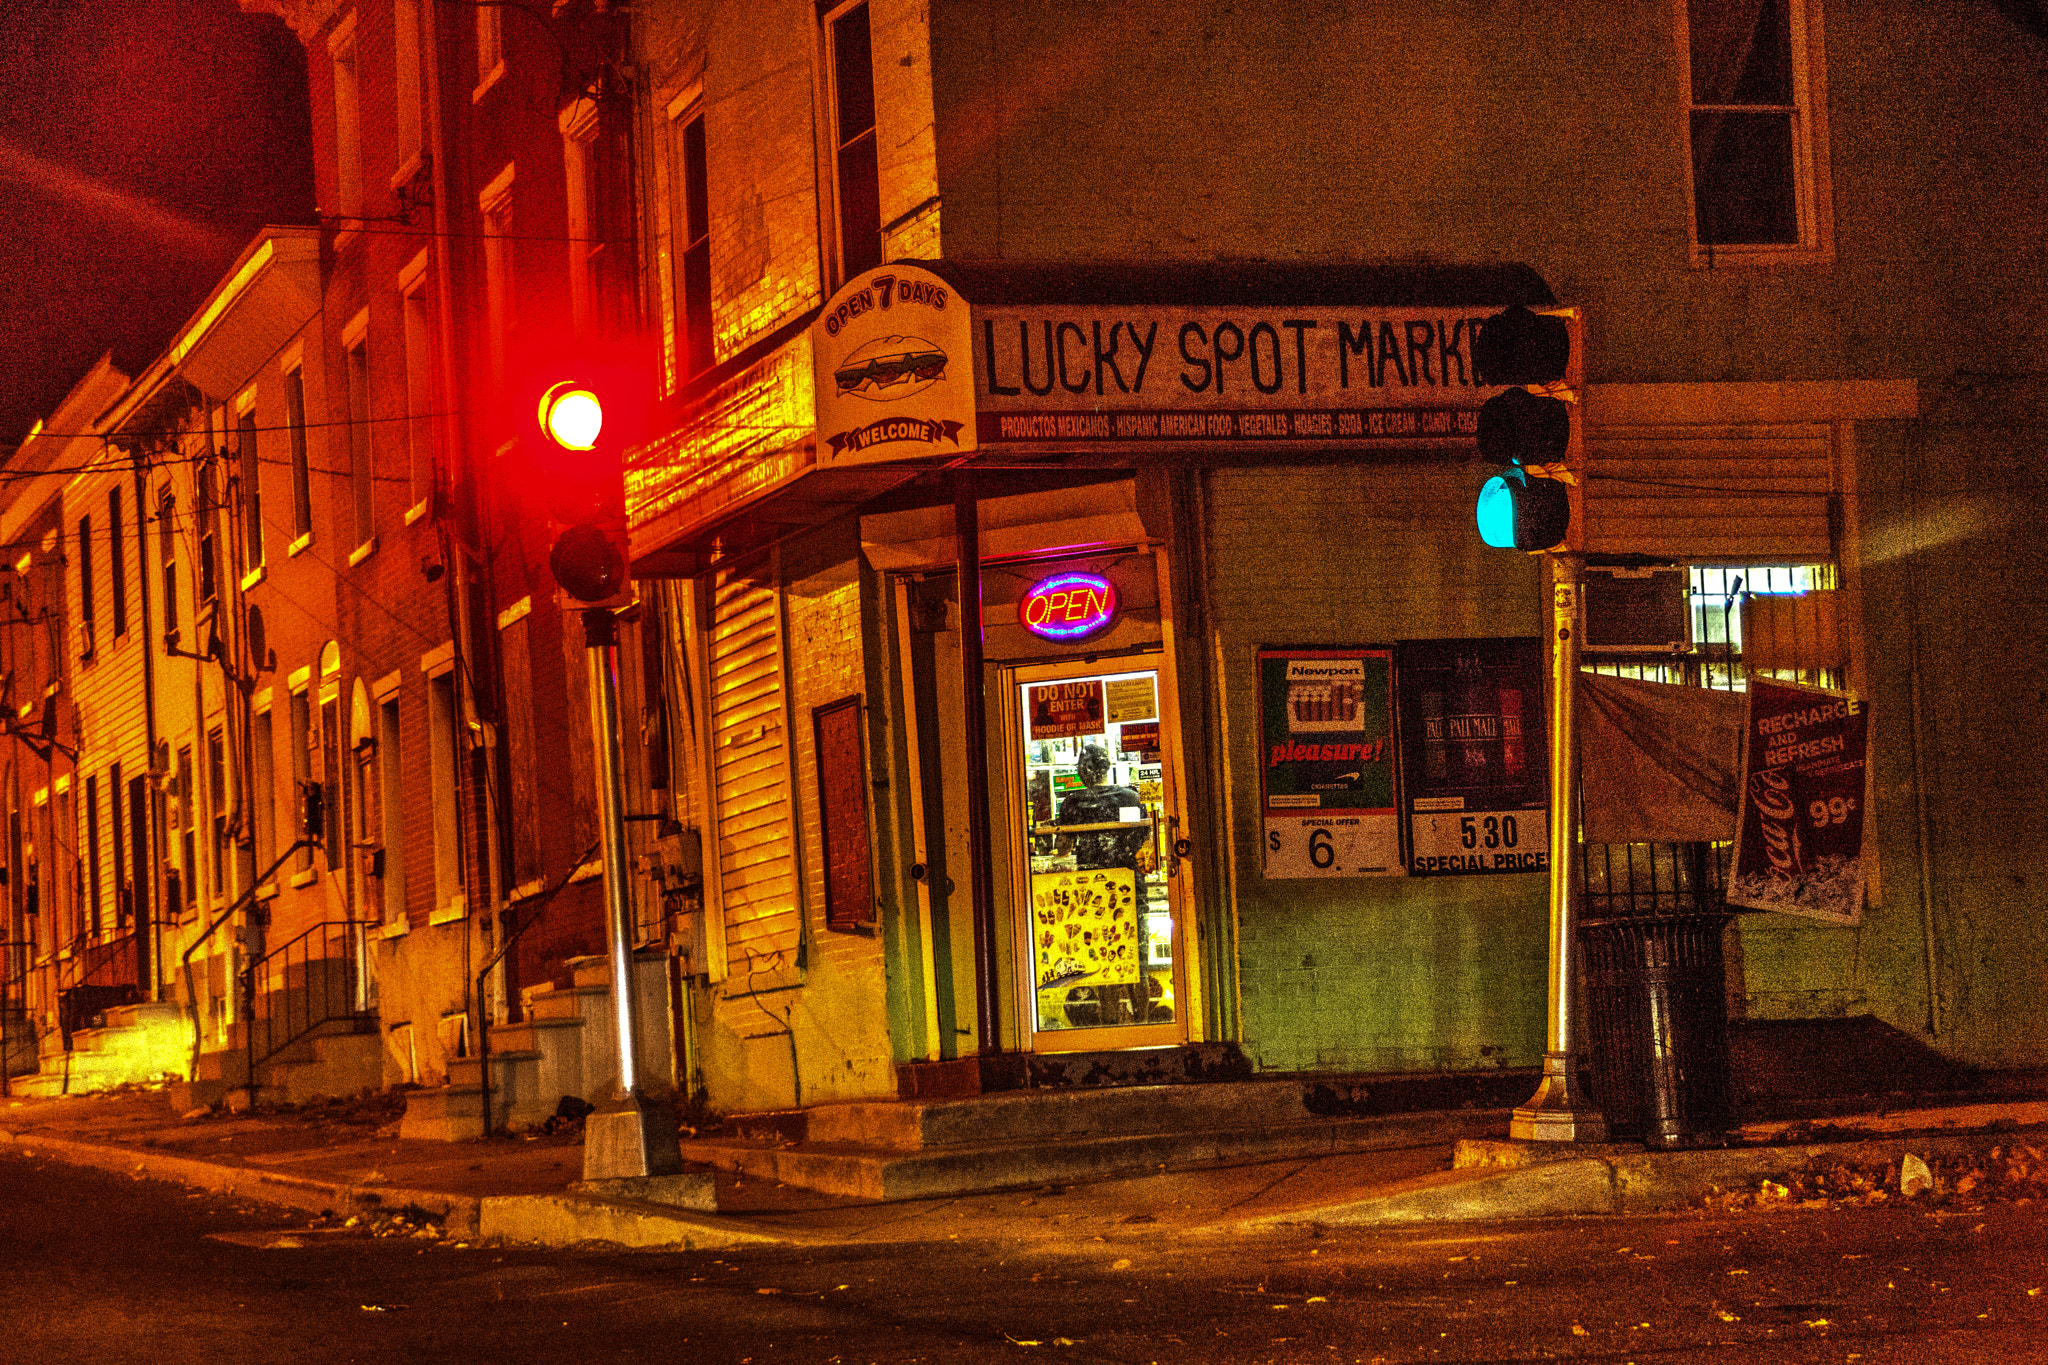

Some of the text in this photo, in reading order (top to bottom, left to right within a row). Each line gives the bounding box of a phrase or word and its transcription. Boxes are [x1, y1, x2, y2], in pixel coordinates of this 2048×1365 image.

[825, 274, 948, 337] OPEN 7 DAYS
[984, 320, 1157, 396] LUCKY
[1178, 319, 1317, 395] SPOT
[858, 422, 929, 447] WELCOME
[1001, 416, 1056, 438] PRODUCTOS
[1057, 415, 1110, 438] MEXICANOS
[1117, 415, 1158, 437] HISPANIC
[1160, 414, 1206, 437] AMERICAN
[1208, 414, 1232, 437] FOOD
[1238, 414, 1288, 436] VEGETALES
[1294, 413, 1332, 435] HOAGIES
[1339, 413, 1363, 435] SODA
[1369, 413, 1384, 434] ICE
[1386, 412, 1415, 434] CREAM
[1026, 585, 1109, 625] OPEN
[1291, 666, 1361, 677] Newport
[1038, 685, 1059, 702] DO
[1064, 681, 1097, 699] NOT
[1050, 698, 1084, 712] ENTER
[1035, 720, 1102, 734] HOODIE OR MASK
[1060, 713, 1076, 721] WITH
[1450, 719, 1469, 737] PALL
[1473, 717, 1497, 737] MALL
[1757, 698, 1860, 736] RECHARGE
[1765, 734, 1845, 766] REFRESH
[1768, 732, 1797, 749] AND
[1269, 738, 1384, 767] pleasure!
[1301, 818, 1360, 826] SPECIAL OFFER
[1460, 815, 1518, 849] 5.30
[1269, 830, 1281, 852] $
[1415, 852, 1547, 872] SPECIAL PRICE
